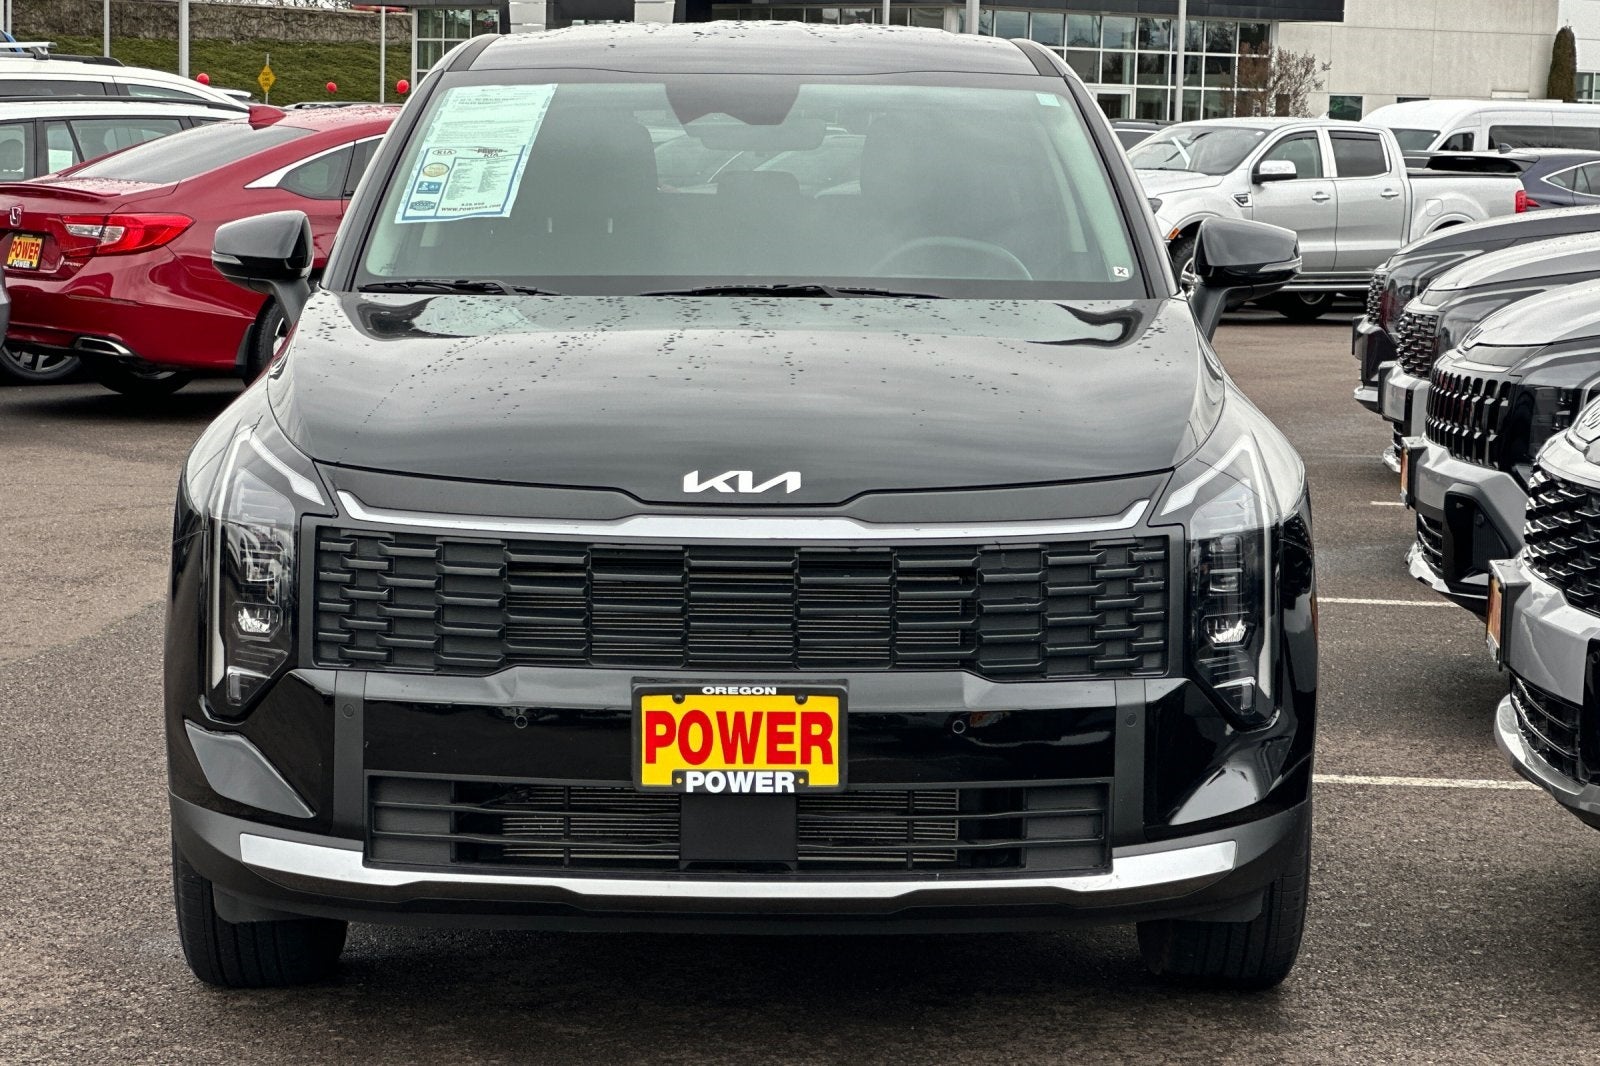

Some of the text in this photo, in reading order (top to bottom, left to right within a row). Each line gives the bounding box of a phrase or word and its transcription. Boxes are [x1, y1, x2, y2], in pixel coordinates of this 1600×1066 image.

[10, 241, 40, 260] POWER
[12, 259, 31, 268] POWER
[683, 470, 801, 494] KIA
[702, 686, 777, 695] OREGON
[645, 709, 834, 766] POWER
[685, 771, 795, 793] POWER
